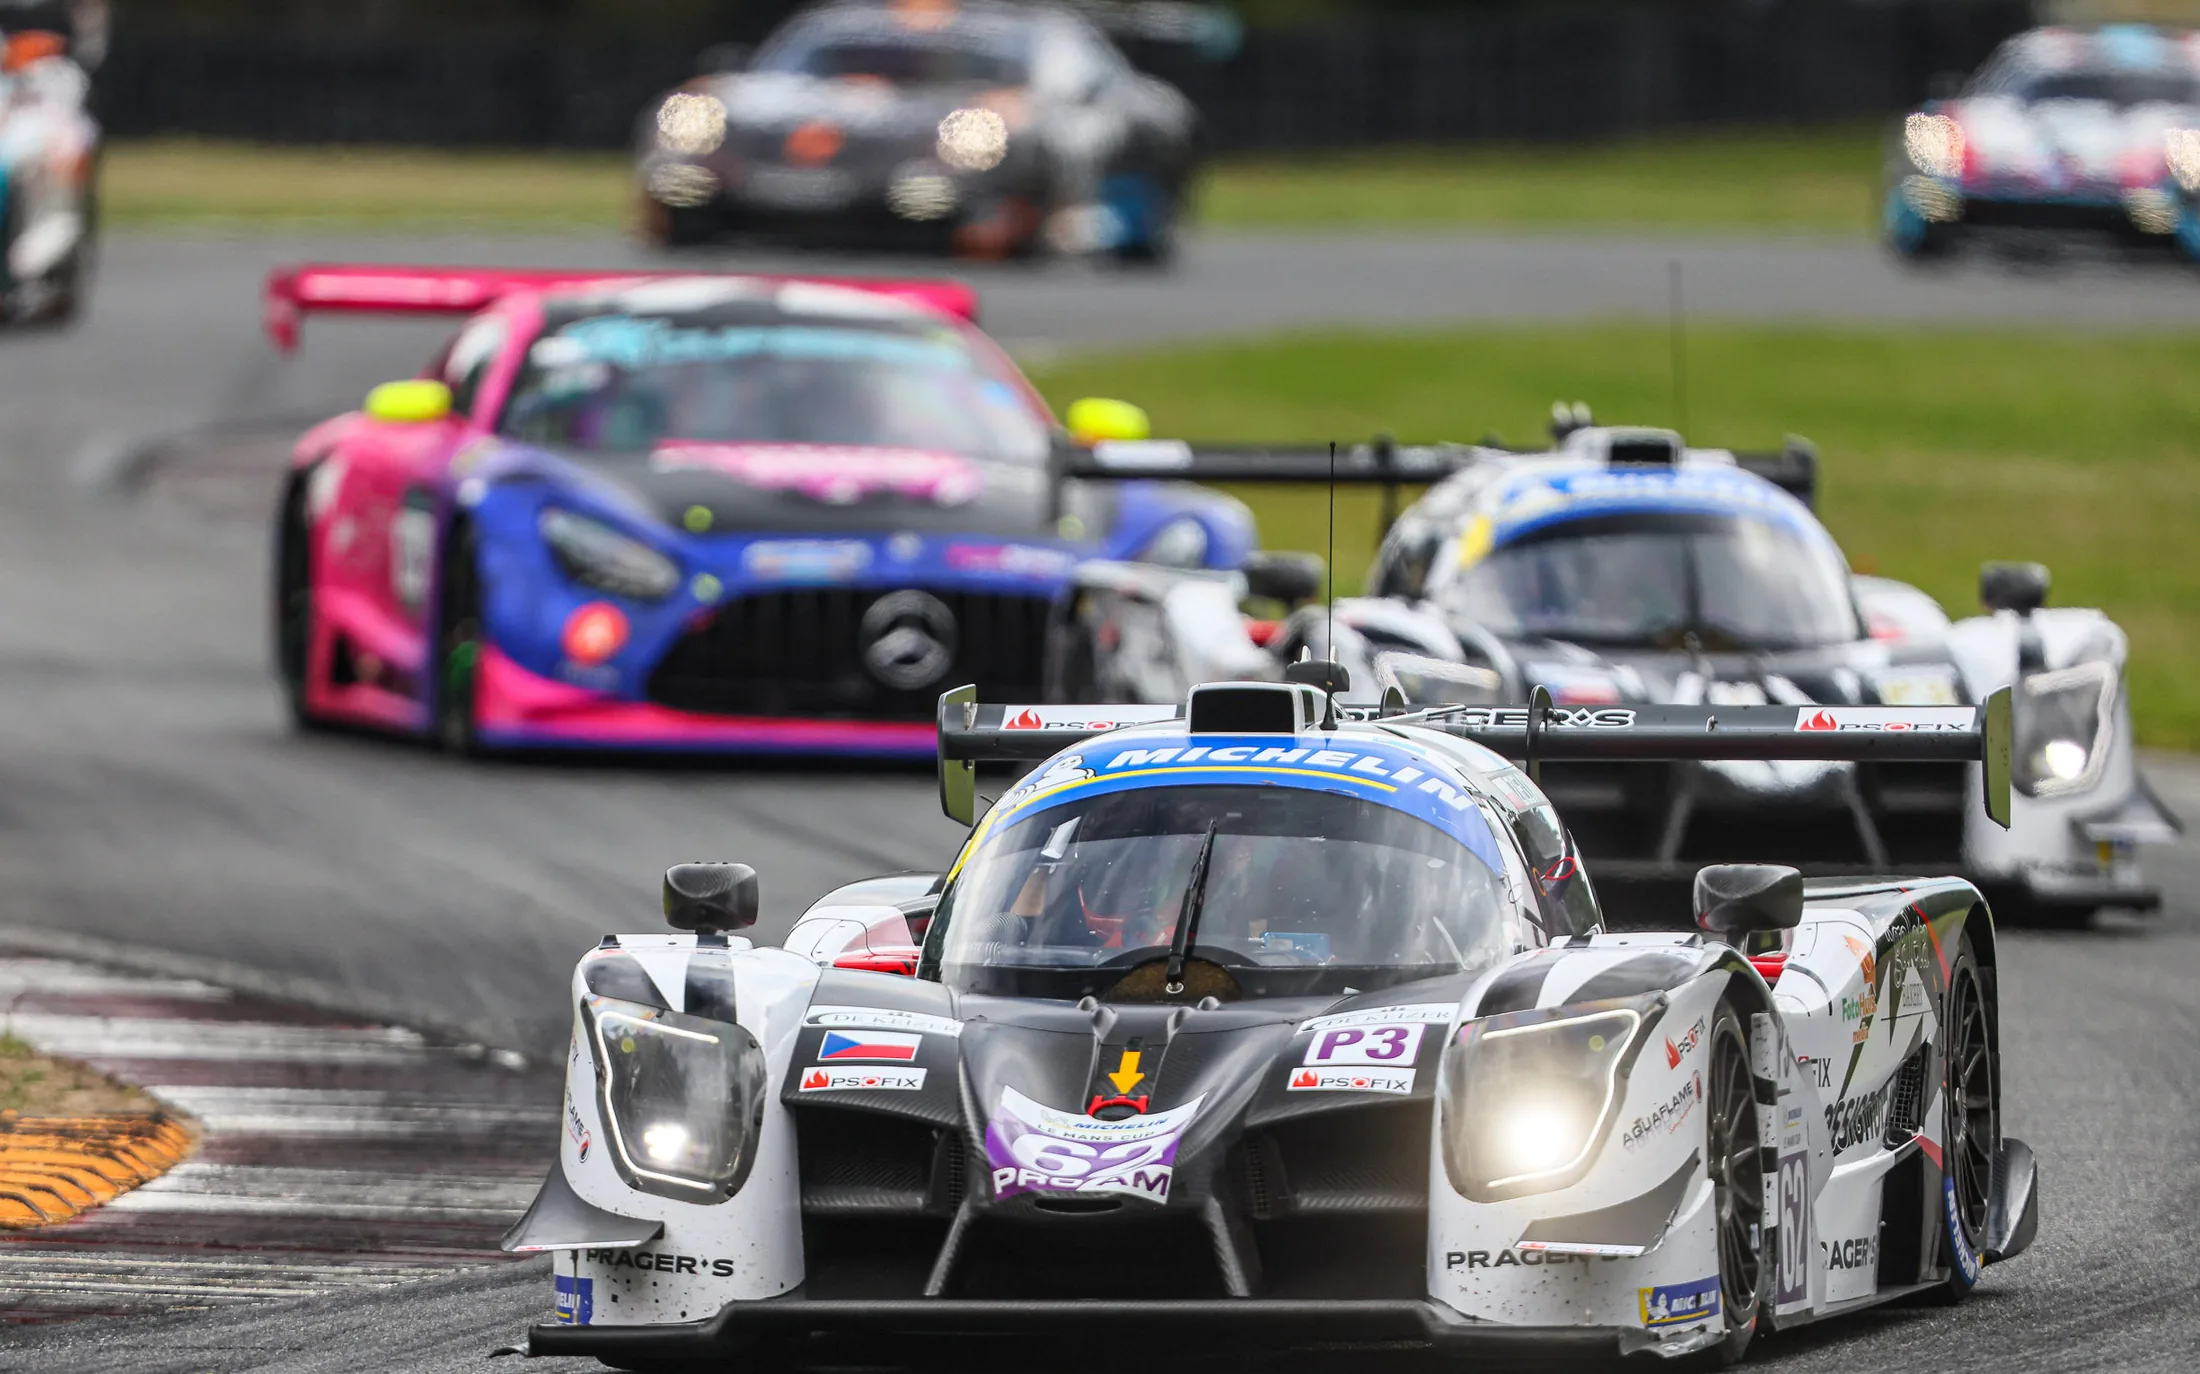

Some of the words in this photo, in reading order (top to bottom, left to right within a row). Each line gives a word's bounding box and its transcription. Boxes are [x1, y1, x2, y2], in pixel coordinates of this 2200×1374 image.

[1105, 746, 1475, 812] MICHELIN
[1316, 1027, 1410, 1060] P3
[1677, 1014, 1707, 1060] PSOFIX
[830, 1077, 918, 1087] PSOFIX
[1319, 1077, 1408, 1091] PSOFIX
[1074, 1117, 1169, 1130] MICHELIN
[1622, 1081, 1694, 1146] AQUAFLAME
[1037, 1124, 1056, 1133] LE
[1063, 1132, 1112, 1141] MANS
[1120, 1131, 1154, 1140] CUP
[1780, 1159, 1805, 1293] 62
